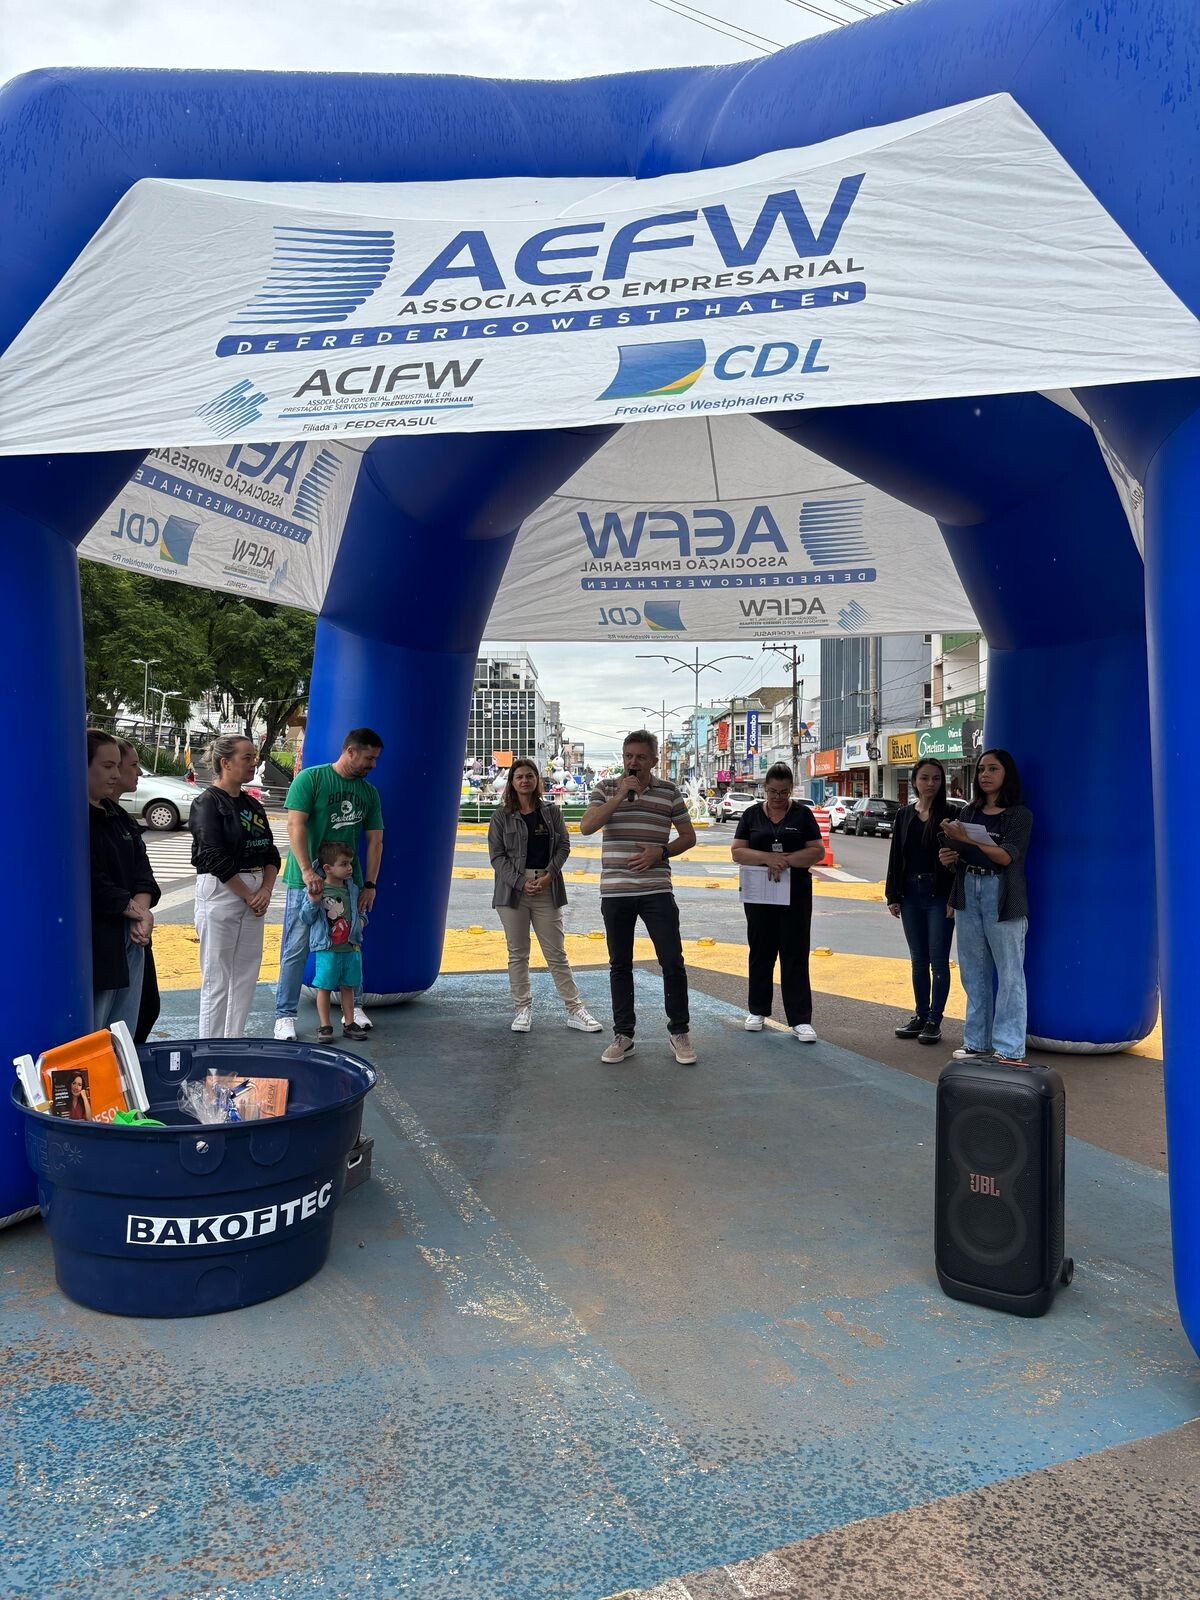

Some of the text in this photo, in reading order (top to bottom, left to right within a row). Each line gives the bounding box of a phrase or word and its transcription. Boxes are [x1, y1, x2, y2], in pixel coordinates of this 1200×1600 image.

[401, 172, 866, 297] AEFW
[397, 257, 865, 316] ASSOCIAÇÃO EMPRESARIAL
[236, 290, 850, 355] DE FREDERICO WESTPHALEN
[713, 338, 830, 381] CDL
[292, 358, 484, 398] ACIFW
[282, 405, 323, 414] PRESTAÇÃO
[334, 402, 368, 411] SERVIÇOS
[381, 399, 421, 408] FREDERICO
[423, 395, 474, 404] WESTPHALEN
[306, 396, 350, 407] ASSOCIAÇÃO
[392, 392, 434, 401] INDUSTRIAL
[614, 391, 805, 417] Frederico Westphalen RS
[302, 416, 438, 432] Filiada à FEDERASUL
[749, 714, 757, 746] Colombo
[892, 743, 913, 759] BRASIL
[92, 1105, 119, 1123] ESO
[969, 1173, 1001, 1197] JBL
